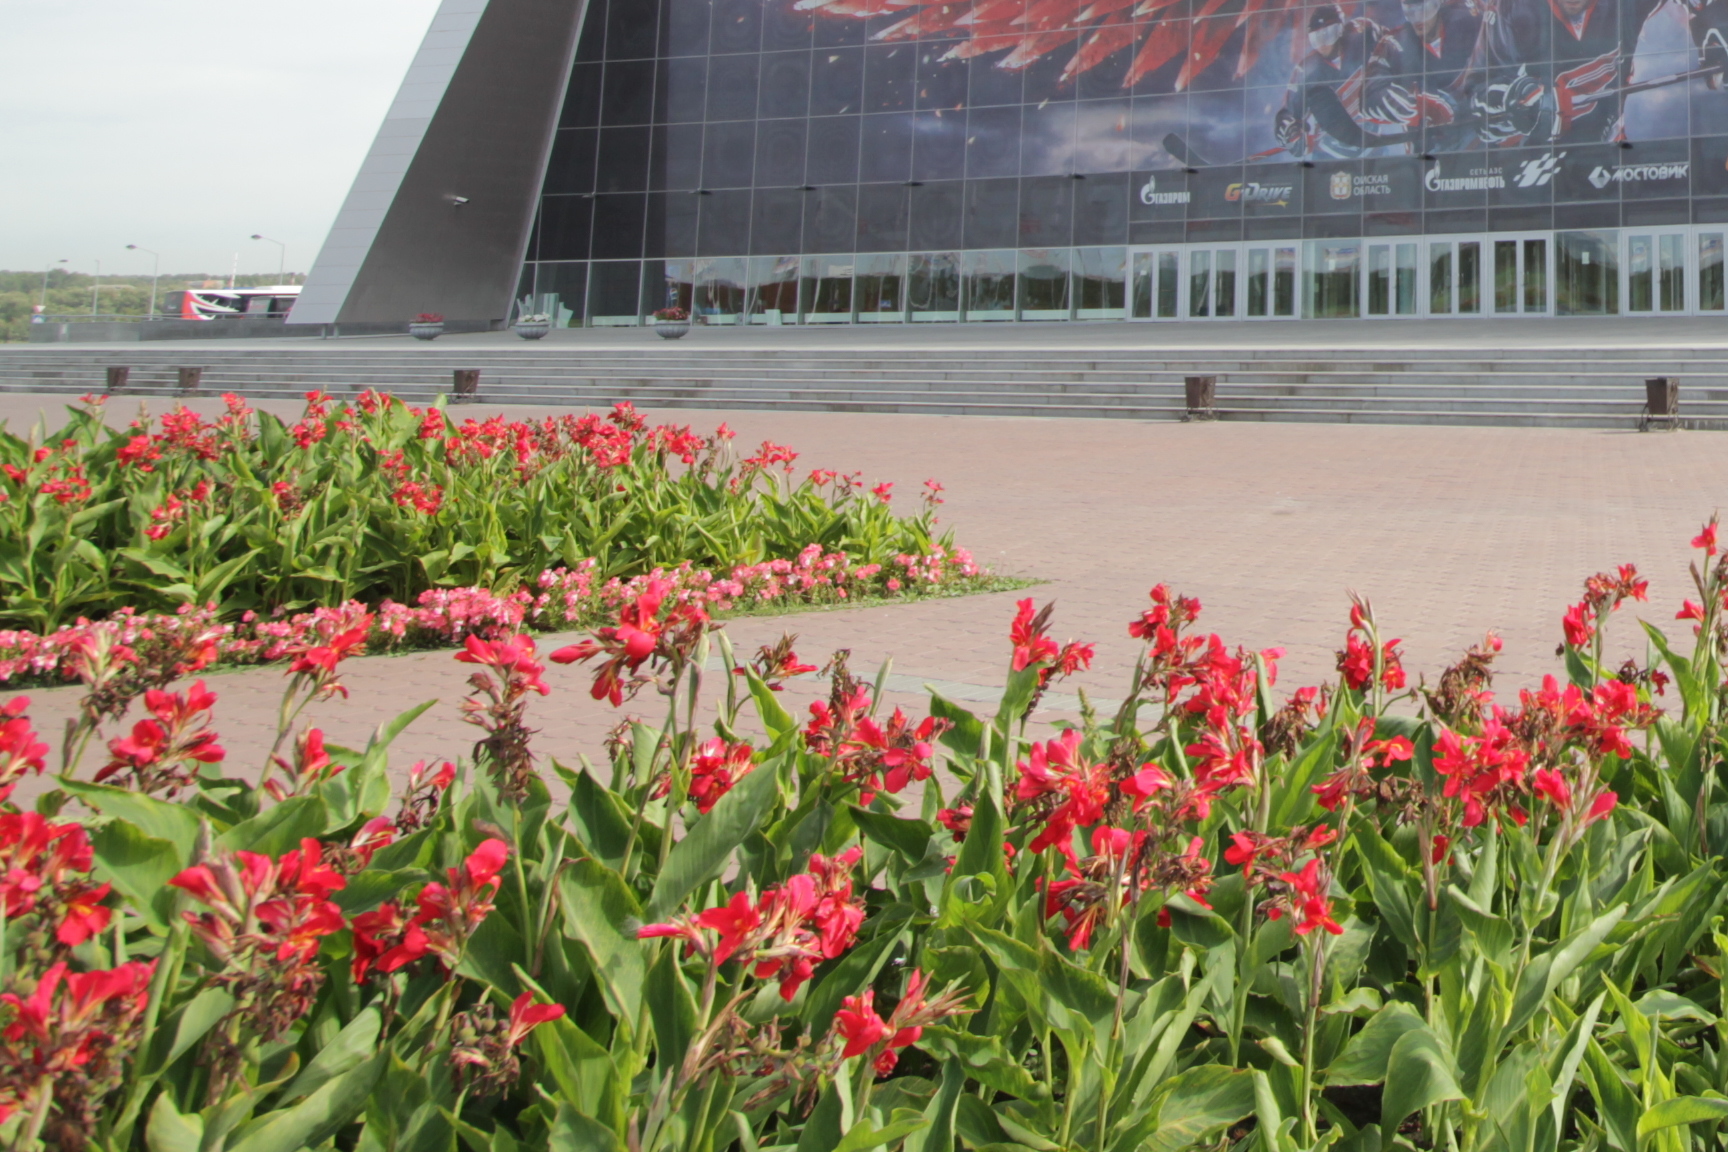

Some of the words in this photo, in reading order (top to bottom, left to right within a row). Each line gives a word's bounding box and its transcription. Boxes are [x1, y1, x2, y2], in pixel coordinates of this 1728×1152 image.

[1611, 164, 1689, 182] МОСТОВИК
[1353, 185, 1391, 196] ОБЛАСТЬ
[1439, 176, 1506, 192] ГАЗПРОМНЕФТЬ
[1154, 191, 1191, 205] ГАЗПРОМ
